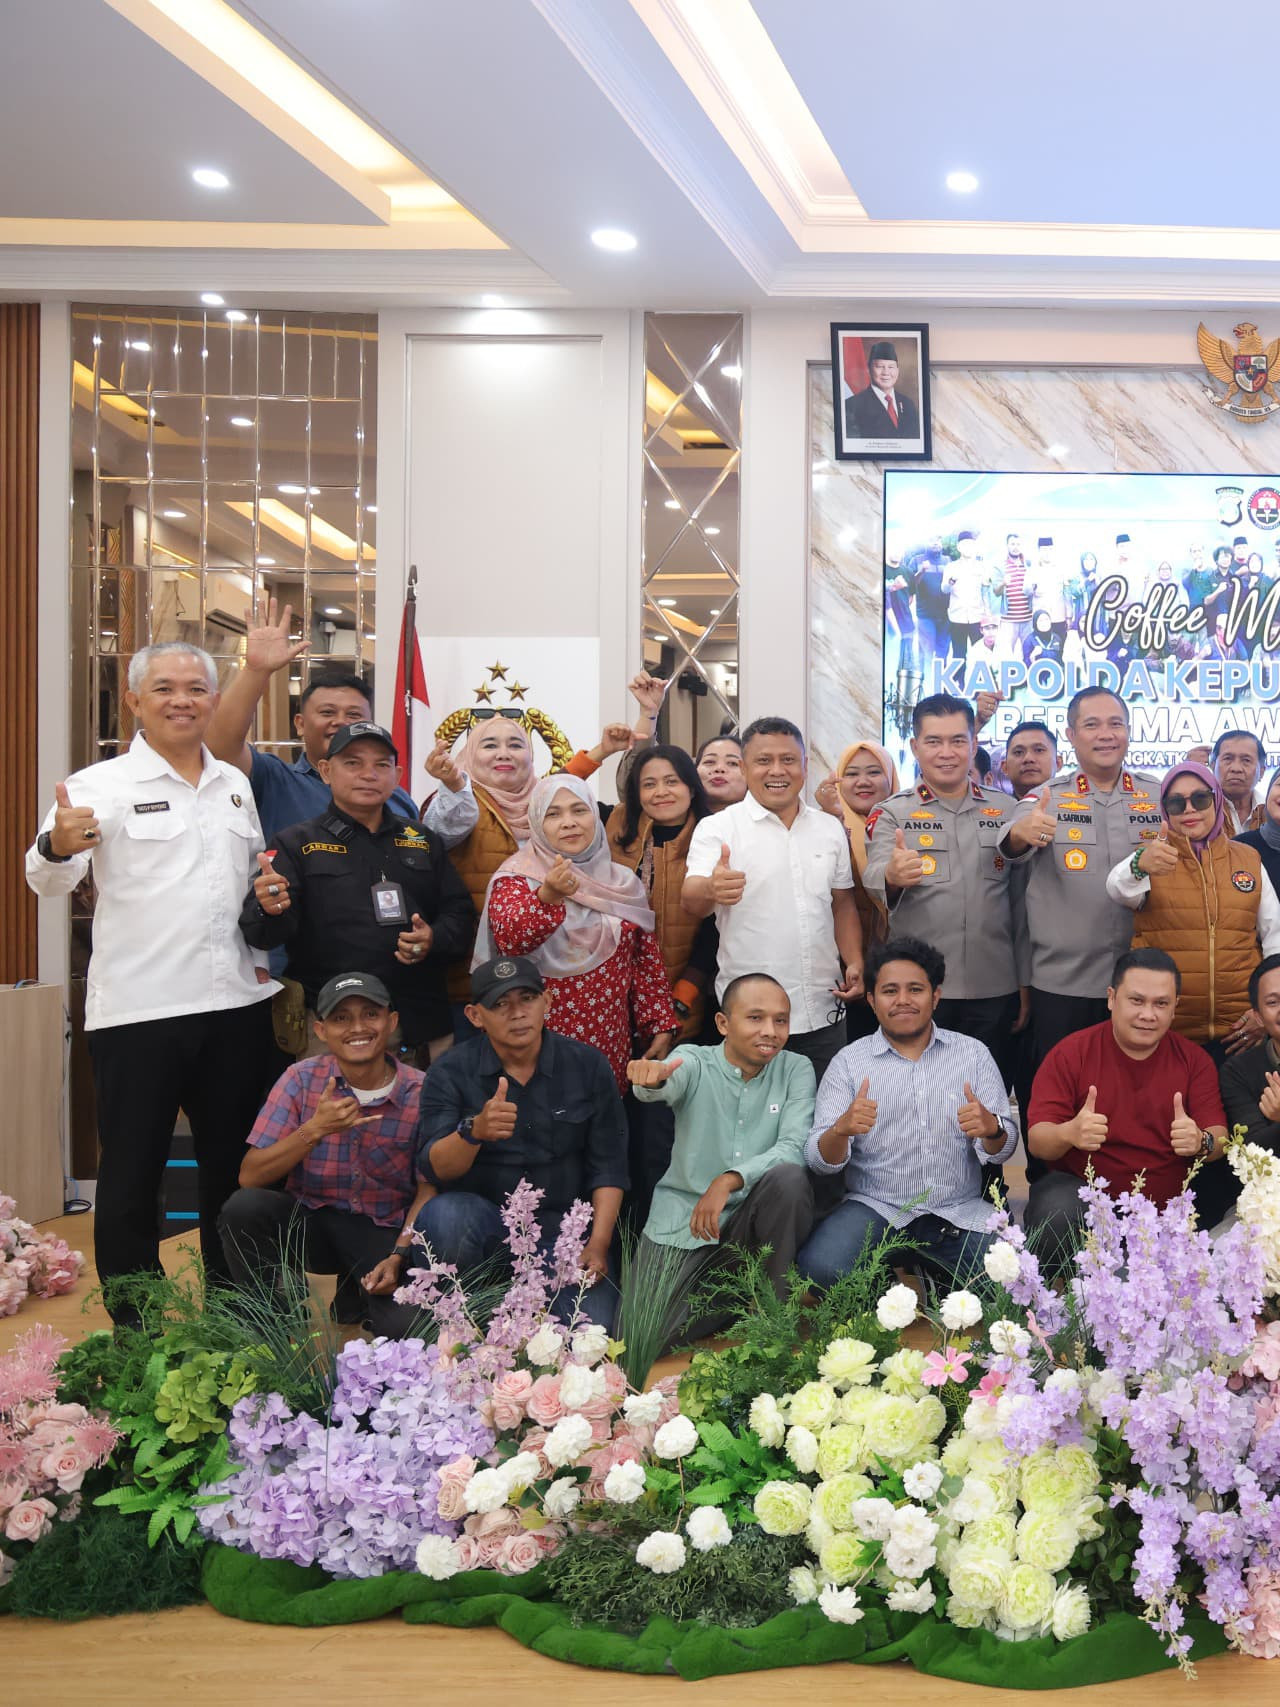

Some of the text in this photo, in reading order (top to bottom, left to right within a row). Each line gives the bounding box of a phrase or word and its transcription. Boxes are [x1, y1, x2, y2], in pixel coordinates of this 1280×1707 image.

[1085, 575, 1206, 651] Coffee
[931, 658, 1156, 701] KAPOLDA
[995, 705, 1203, 743] BERMA
[904, 821, 943, 830] ANOM
[1129, 815, 1162, 825] POLRI
